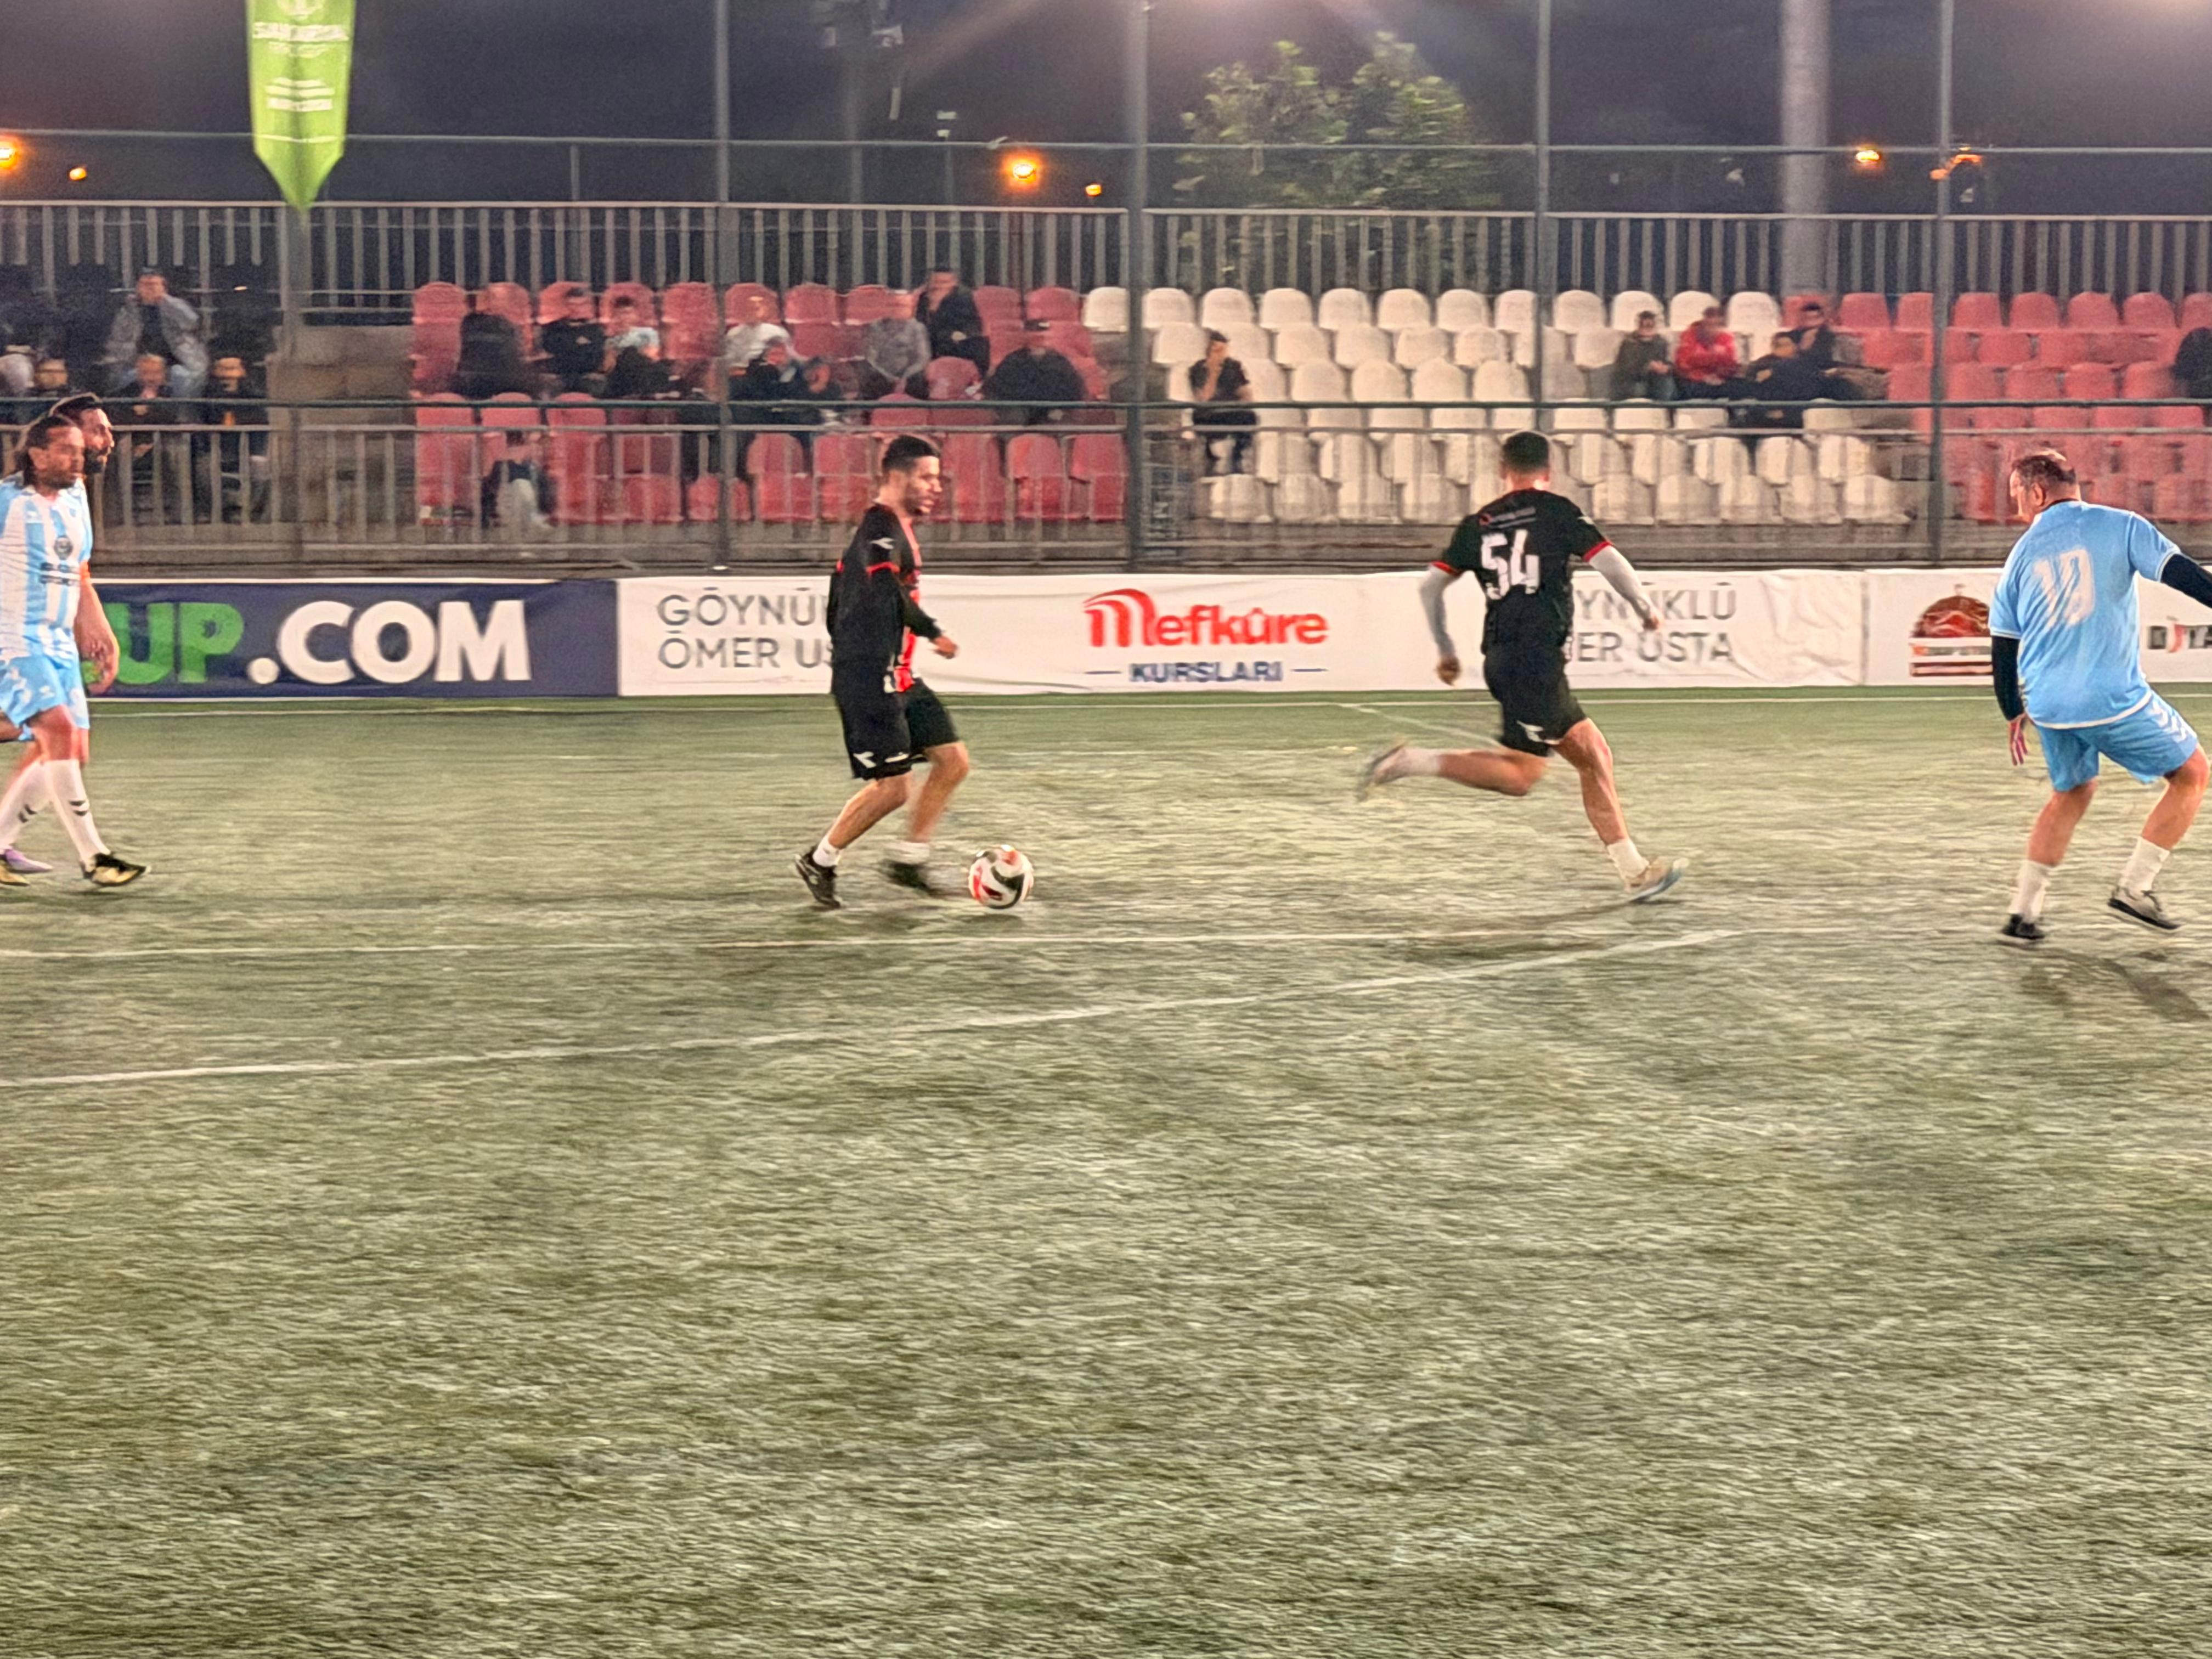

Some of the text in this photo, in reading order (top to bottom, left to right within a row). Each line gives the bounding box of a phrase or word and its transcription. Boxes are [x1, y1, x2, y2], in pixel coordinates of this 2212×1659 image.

[1481, 528, 1539, 600] 54
[658, 587, 828, 626] GÖYNÜ
[82, 600, 531, 684] UP.COM
[658, 630, 780, 669] ÖMER
[1577, 631, 1735, 662] ER USTA
[1128, 661, 1283, 682] KURSLARI
